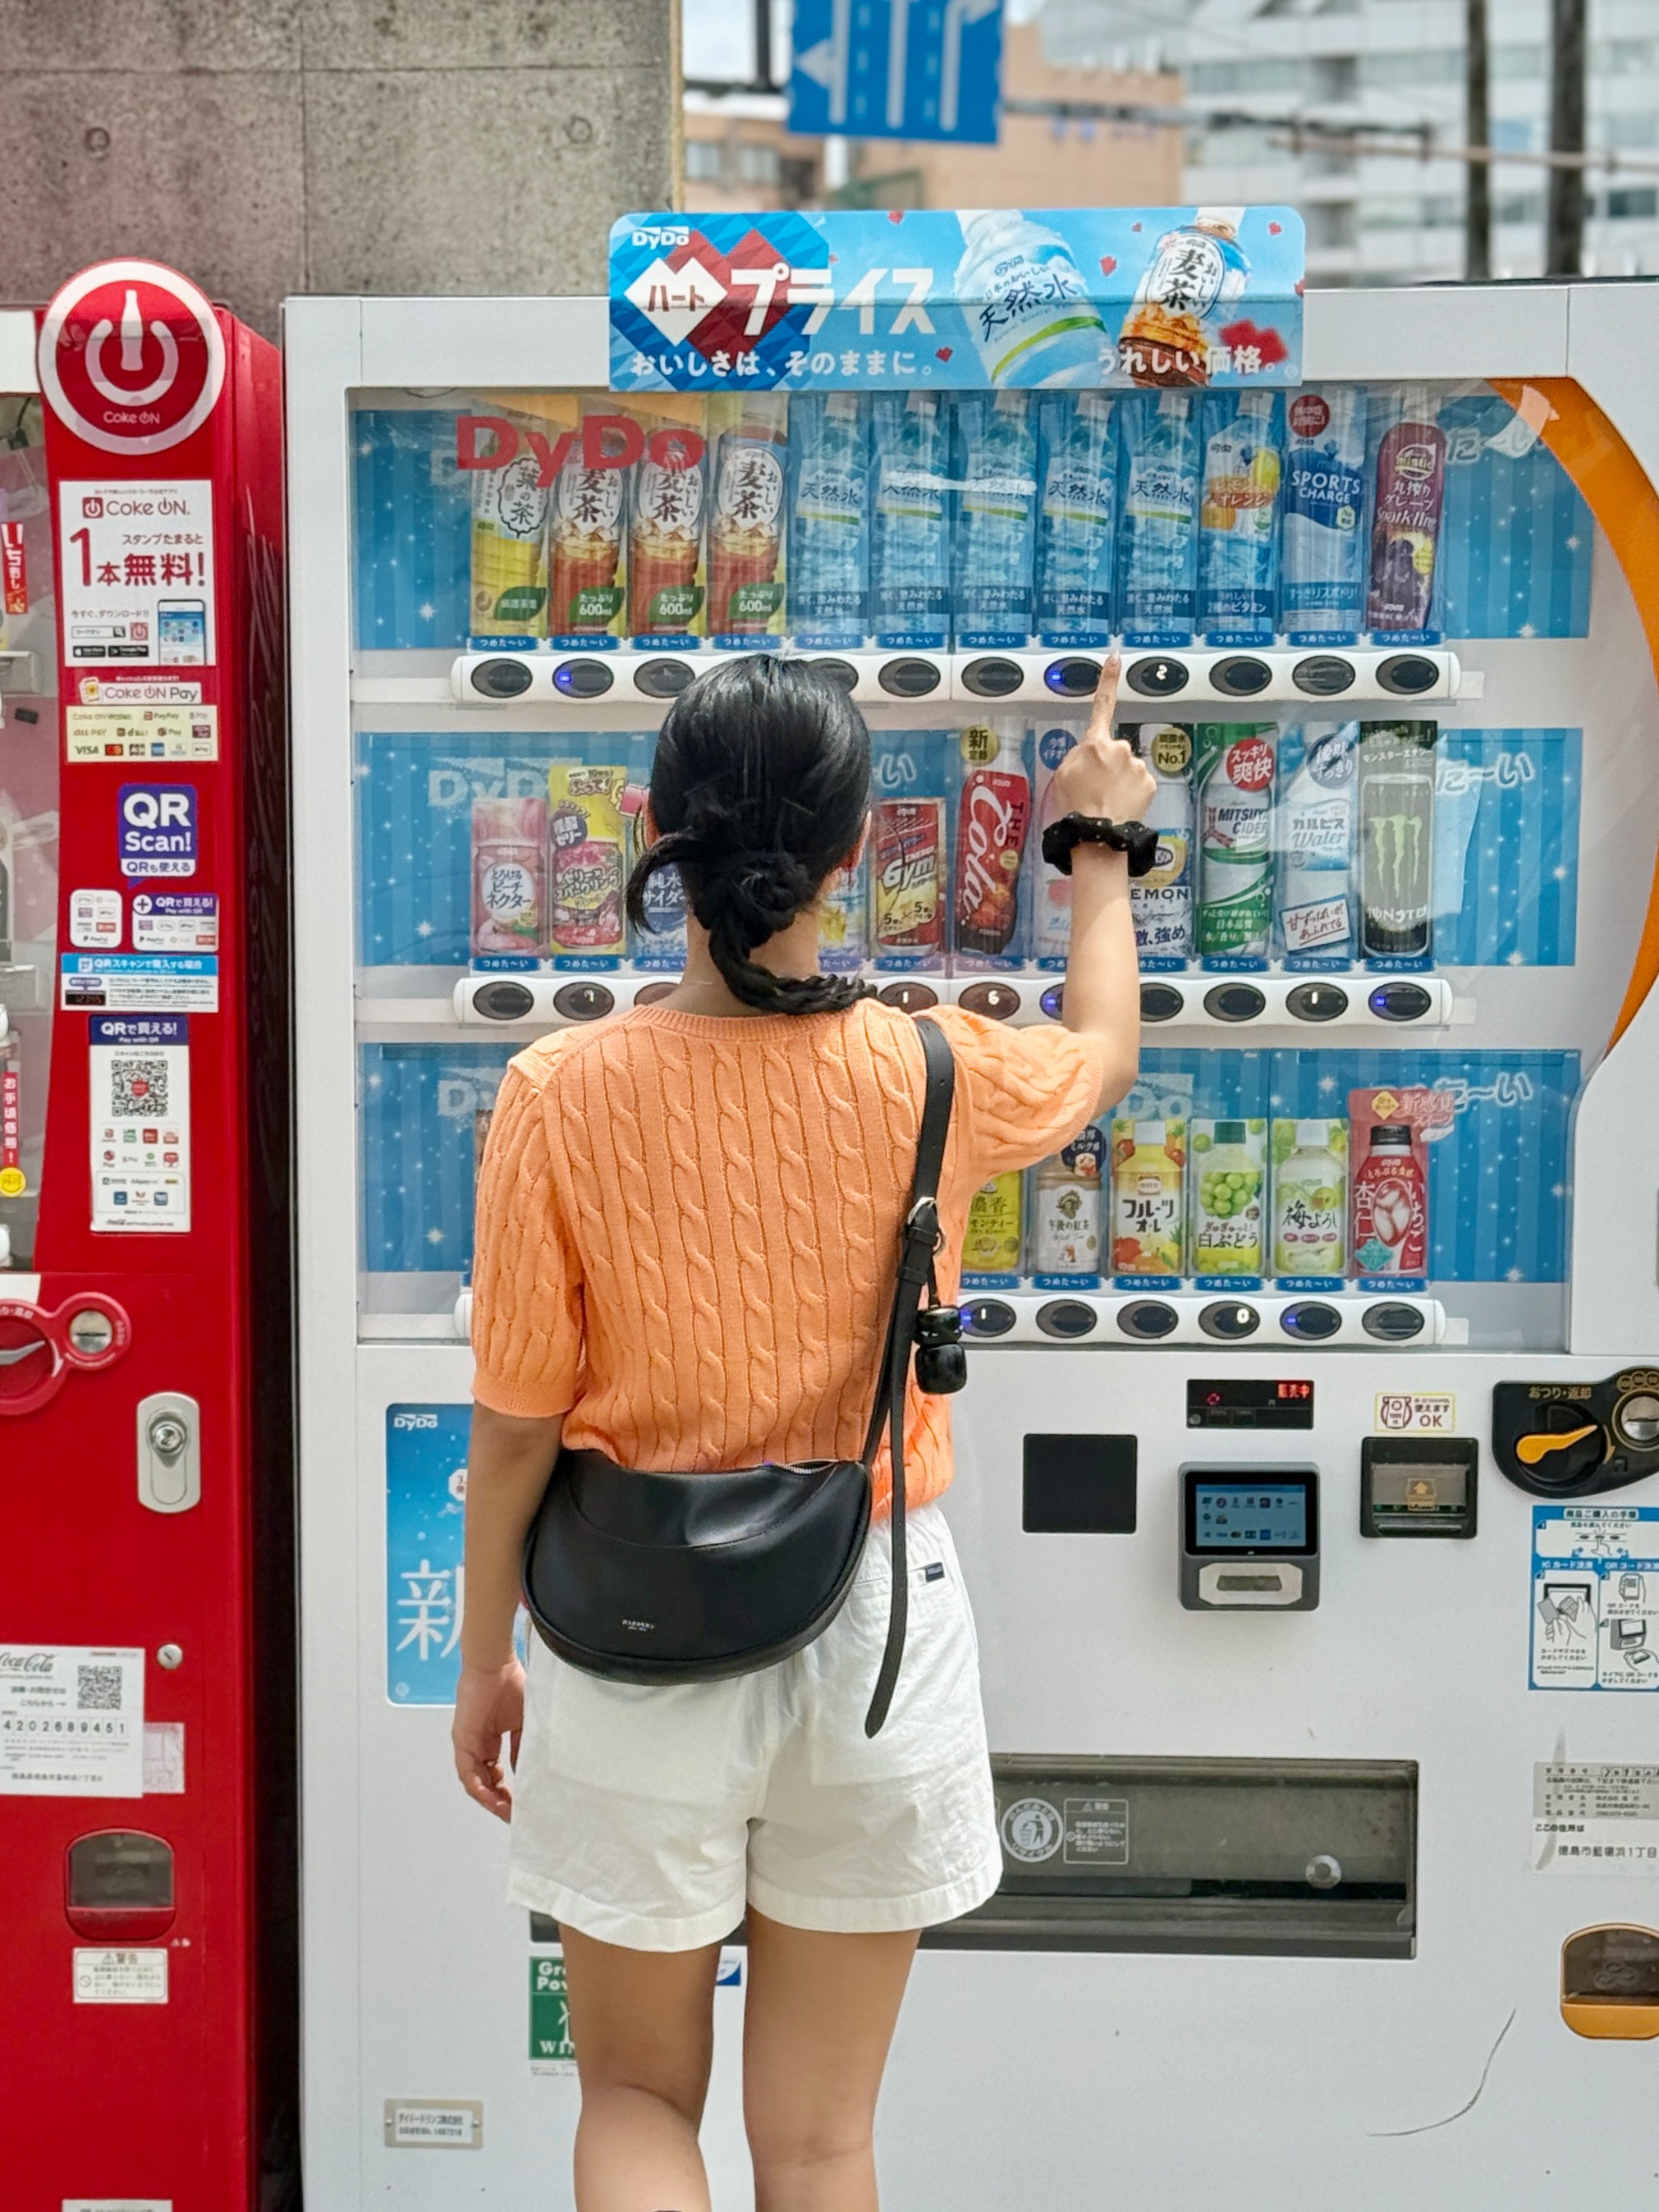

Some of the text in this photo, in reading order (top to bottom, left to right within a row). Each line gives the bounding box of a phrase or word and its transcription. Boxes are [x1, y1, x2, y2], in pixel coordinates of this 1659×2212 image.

[631, 227, 690, 248] DyDo
[1162, 250, 1206, 310] 麦茶
[648, 283, 706, 314] ハート
[731, 265, 937, 337] プライス
[979, 274, 1078, 342] 天然水
[631, 348, 934, 378] おいしさは、そのままに。
[1098, 345, 1276, 375] うれしい価格。
[103, 411, 137, 424] Coke
[456, 415, 704, 488] DyDo
[732, 460, 767, 520] 麦茶
[1133, 480, 1190, 505] 天然水
[1291, 470, 1362, 496] SPORTS
[801, 482, 859, 506] 天然水
[1047, 481, 1107, 506] 天然水
[1221, 493, 1268, 506] オレンジ
[1299, 487, 1352, 504] CHARGE
[106, 500, 155, 516] Coke
[121, 533, 204, 546] スタンプたまると
[579, 593, 614, 604] たっぷり
[659, 593, 694, 604] たっぷり
[739, 590, 775, 601] たっぷり
[105, 686, 141, 699] Coke
[169, 686, 199, 703] Pay
[969, 729, 988, 749] 新
[75, 745, 100, 756] VISA
[1157, 750, 1187, 765] No.1
[1231, 744, 1267, 762] スッキリ
[1233, 758, 1272, 784] 爽快
[1314, 760, 1354, 781] すっきり
[124, 792, 192, 830] QR
[1292, 818, 1345, 830] カルピス
[125, 831, 192, 853] Scan!
[1290, 829, 1346, 849] Water
[963, 785, 1014, 914] Cola
[647, 872, 683, 890] 純水
[882, 853, 937, 892] Gym
[486, 893, 532, 909] ネクター
[1130, 887, 1189, 900] EMON
[1136, 924, 1186, 945] 激、強め
[100, 1021, 178, 1036] QRで買える!
[1121, 1198, 1175, 1220] フルーツ
[1282, 1199, 1338, 1230] 梅よろし
[1406, 1180, 1426, 1253] いちご
[970, 1219, 1015, 1229] モンティー
[1048, 1219, 1090, 1231] 午後の紅茶
[1198, 1232, 1258, 1248] 白ぶどう
[1528, 1387, 1593, 1400] おつり・返却
[393, 1413, 438, 1431] DyDo
[1418, 1415, 1443, 1428] OK
